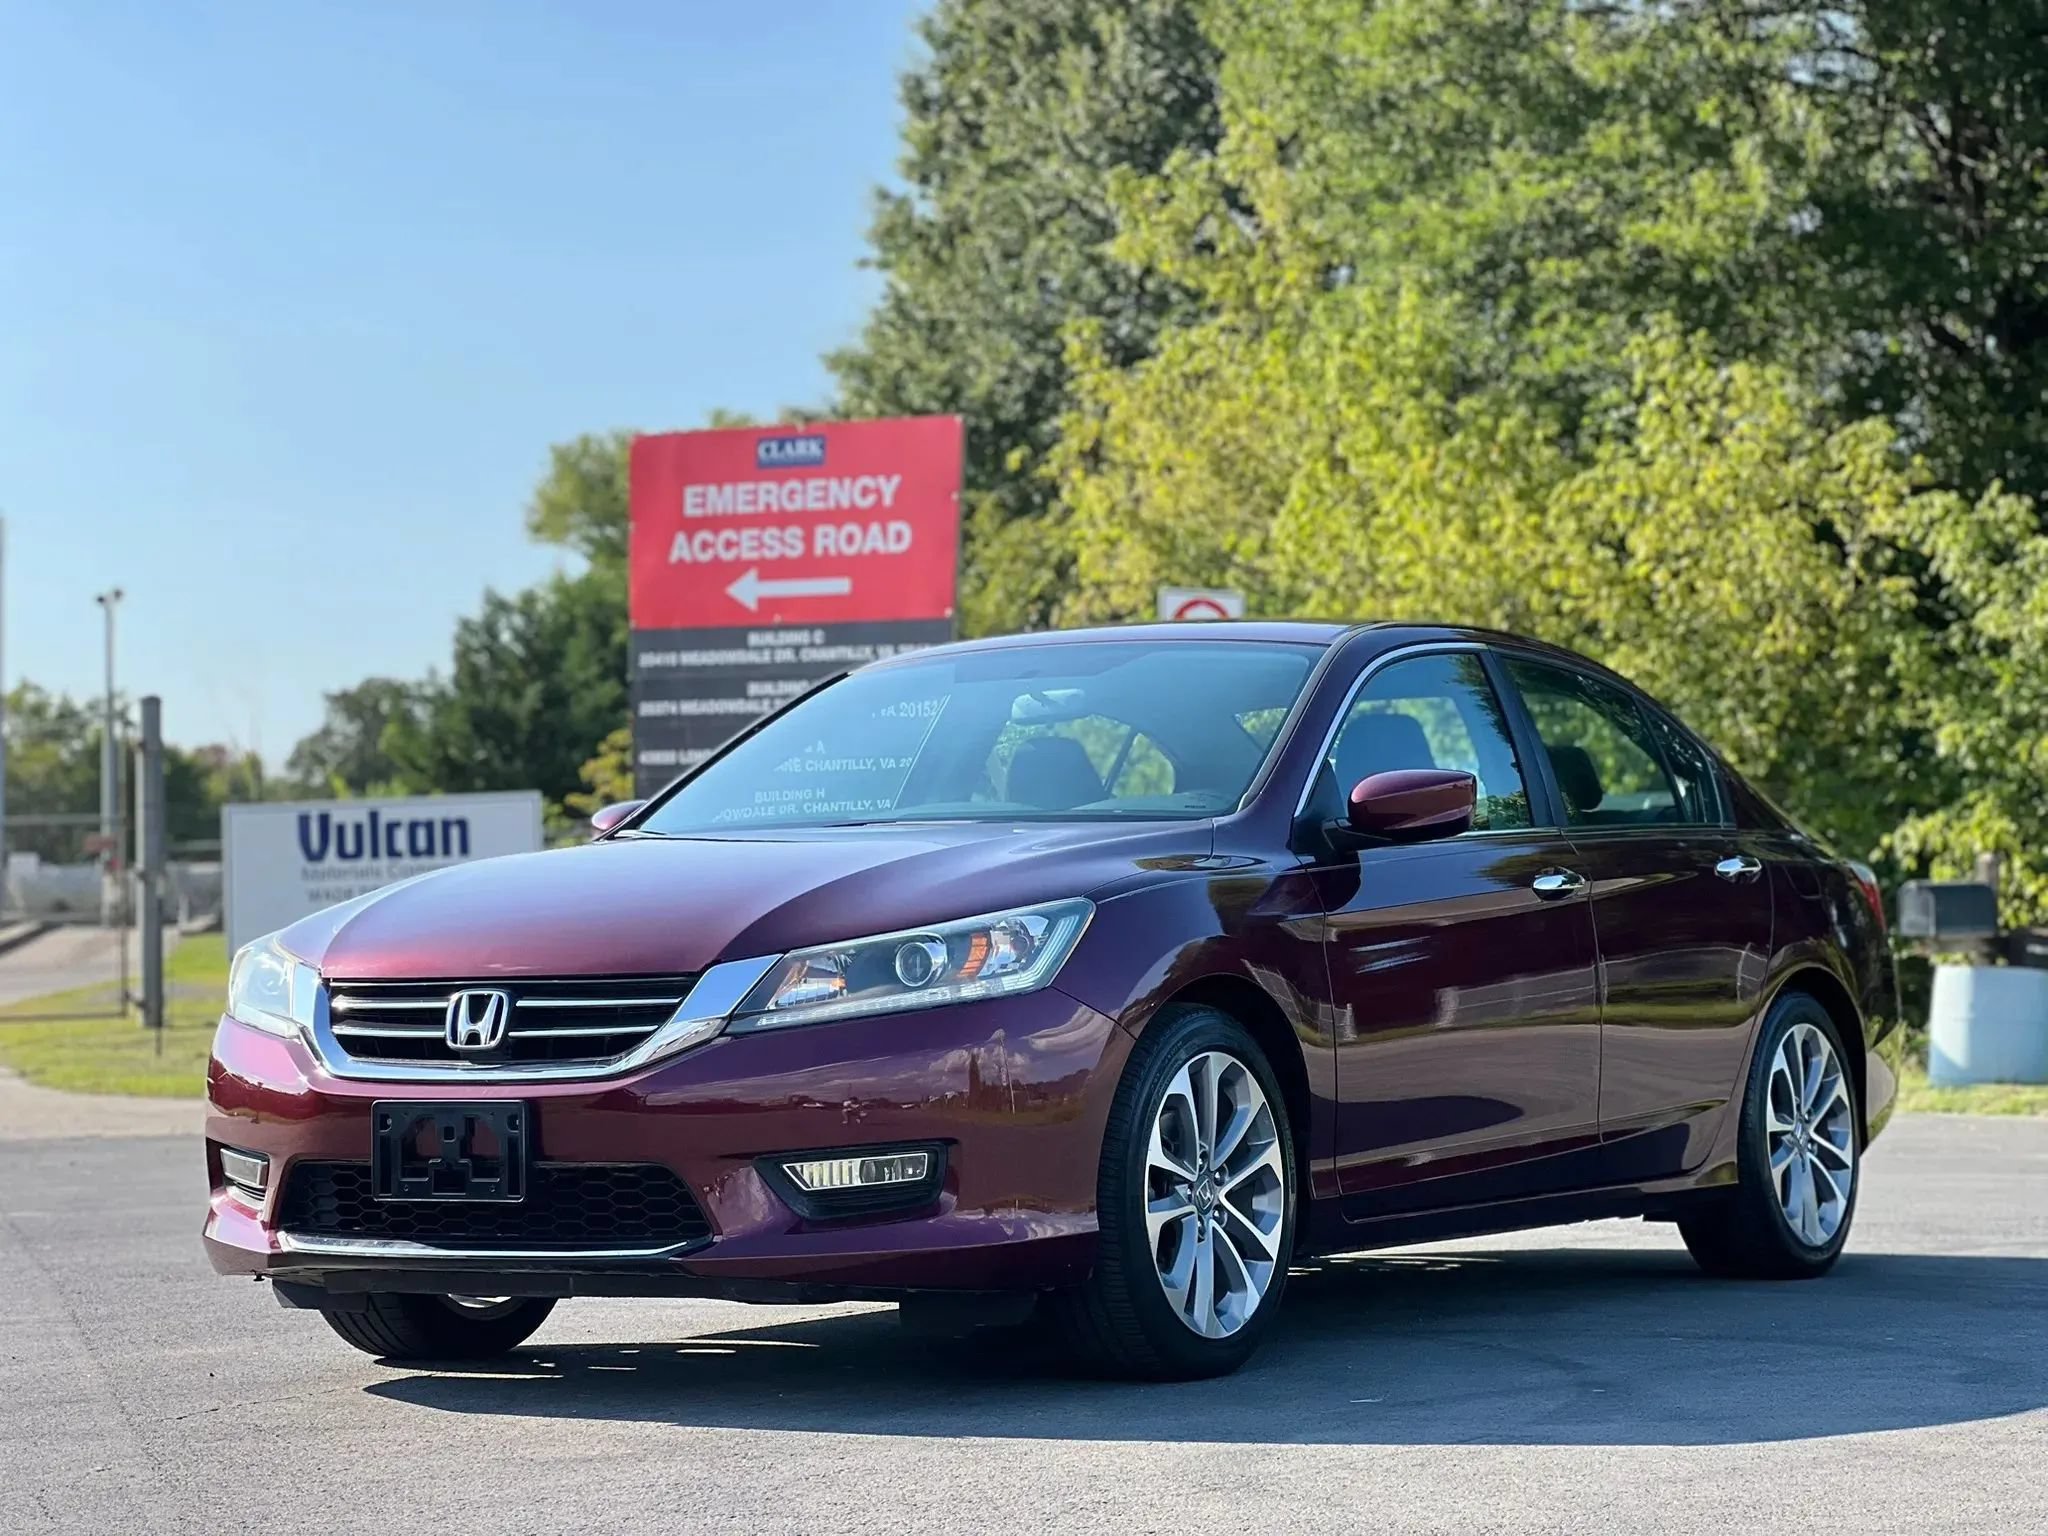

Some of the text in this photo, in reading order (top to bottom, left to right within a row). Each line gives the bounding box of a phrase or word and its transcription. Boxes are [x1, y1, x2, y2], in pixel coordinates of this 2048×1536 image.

[758, 438, 823, 459] CLARK
[683, 475, 901, 517] EMERGENCY
[669, 521, 912, 564] ACCESS ROAD
[747, 631, 811, 647] BUILDING
[805, 758, 876, 772] CHANTILLY,
[880, 758, 896, 769] VA
[755, 790, 812, 804] BUILDING
[877, 799, 891, 809] VA
[298, 811, 471, 862] Vulcan
